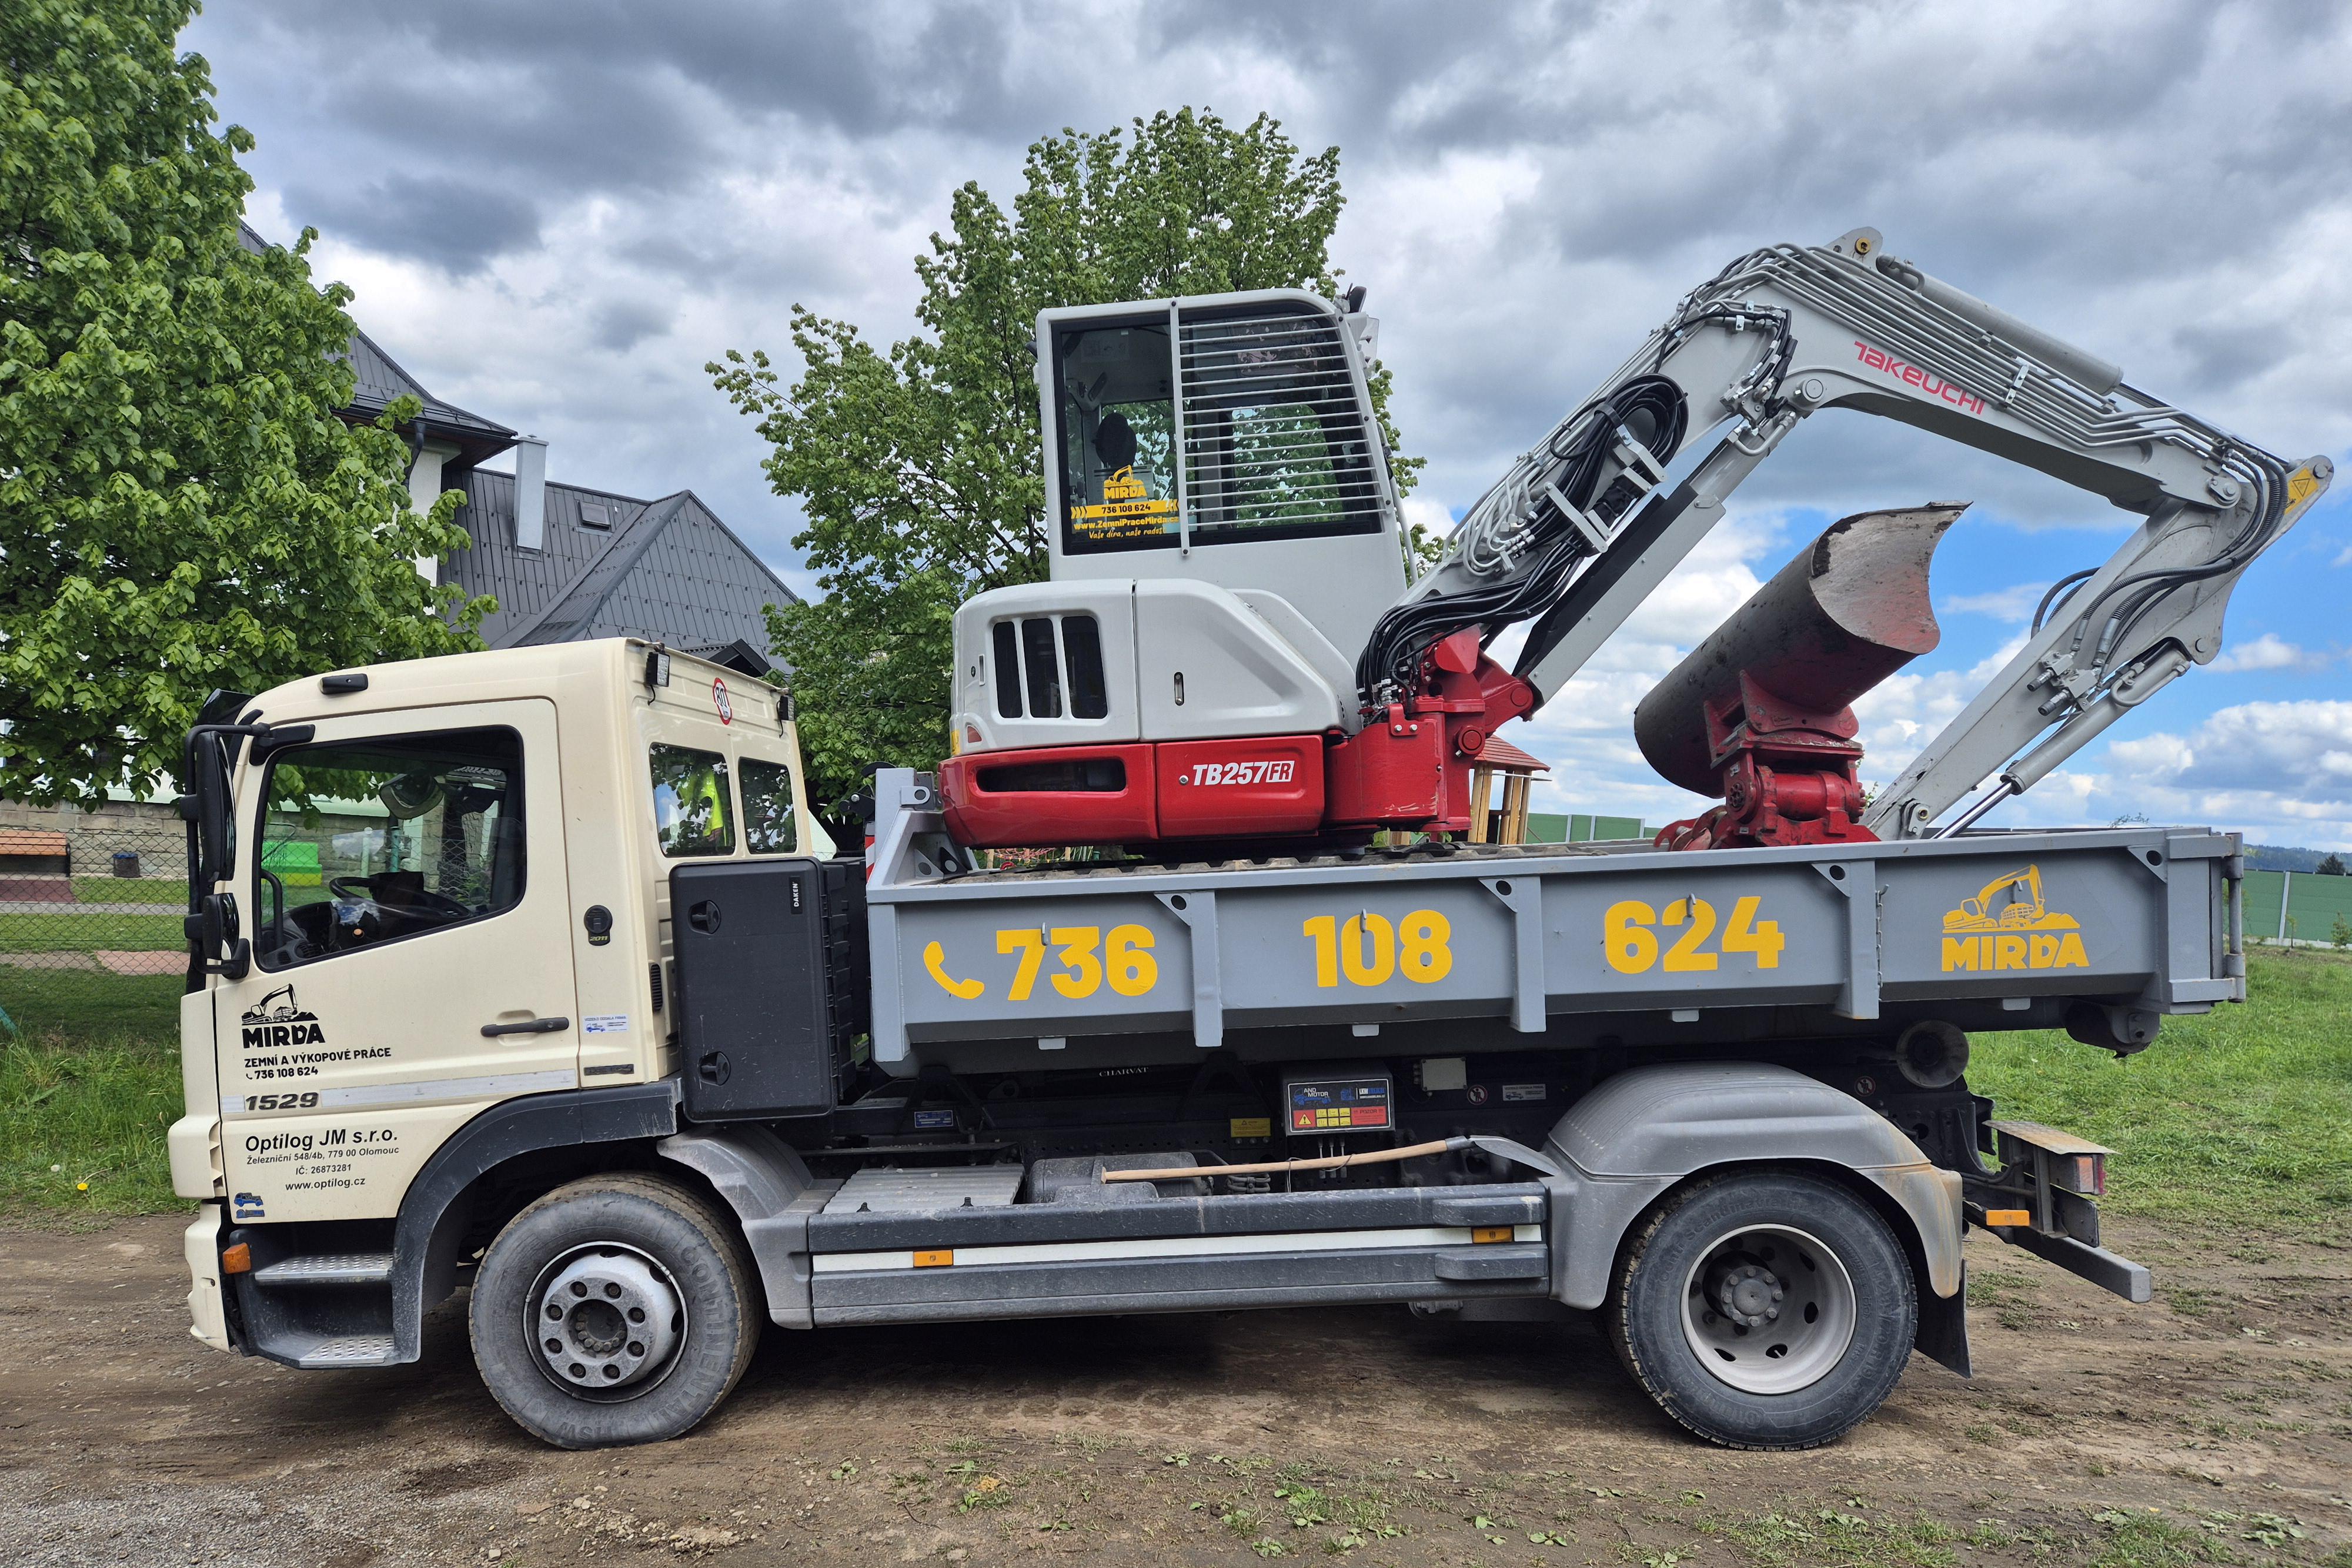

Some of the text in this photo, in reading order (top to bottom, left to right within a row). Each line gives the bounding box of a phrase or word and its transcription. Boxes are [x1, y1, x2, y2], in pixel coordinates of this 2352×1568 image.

[1120, 505, 1132, 513] 108
[1135, 503, 1151, 512] 624
[996, 895, 1786, 1001] 736 108 624
[244, 1047, 392, 1068] ZEMNÍ A VÝKOPOVÉ PRÁCE
[255, 1066, 318, 1079] 736 108 624
[246, 1092, 319, 1111] 1529
[246, 1129, 397, 1154] Optilog JM s.r.o.
[247, 1147, 399, 1165] Železniční 548/4b, 779 00 Olomouc
[296, 1164, 351, 1175] IČ: 26873281
[285, 1178, 366, 1191] www.optilog.cz
